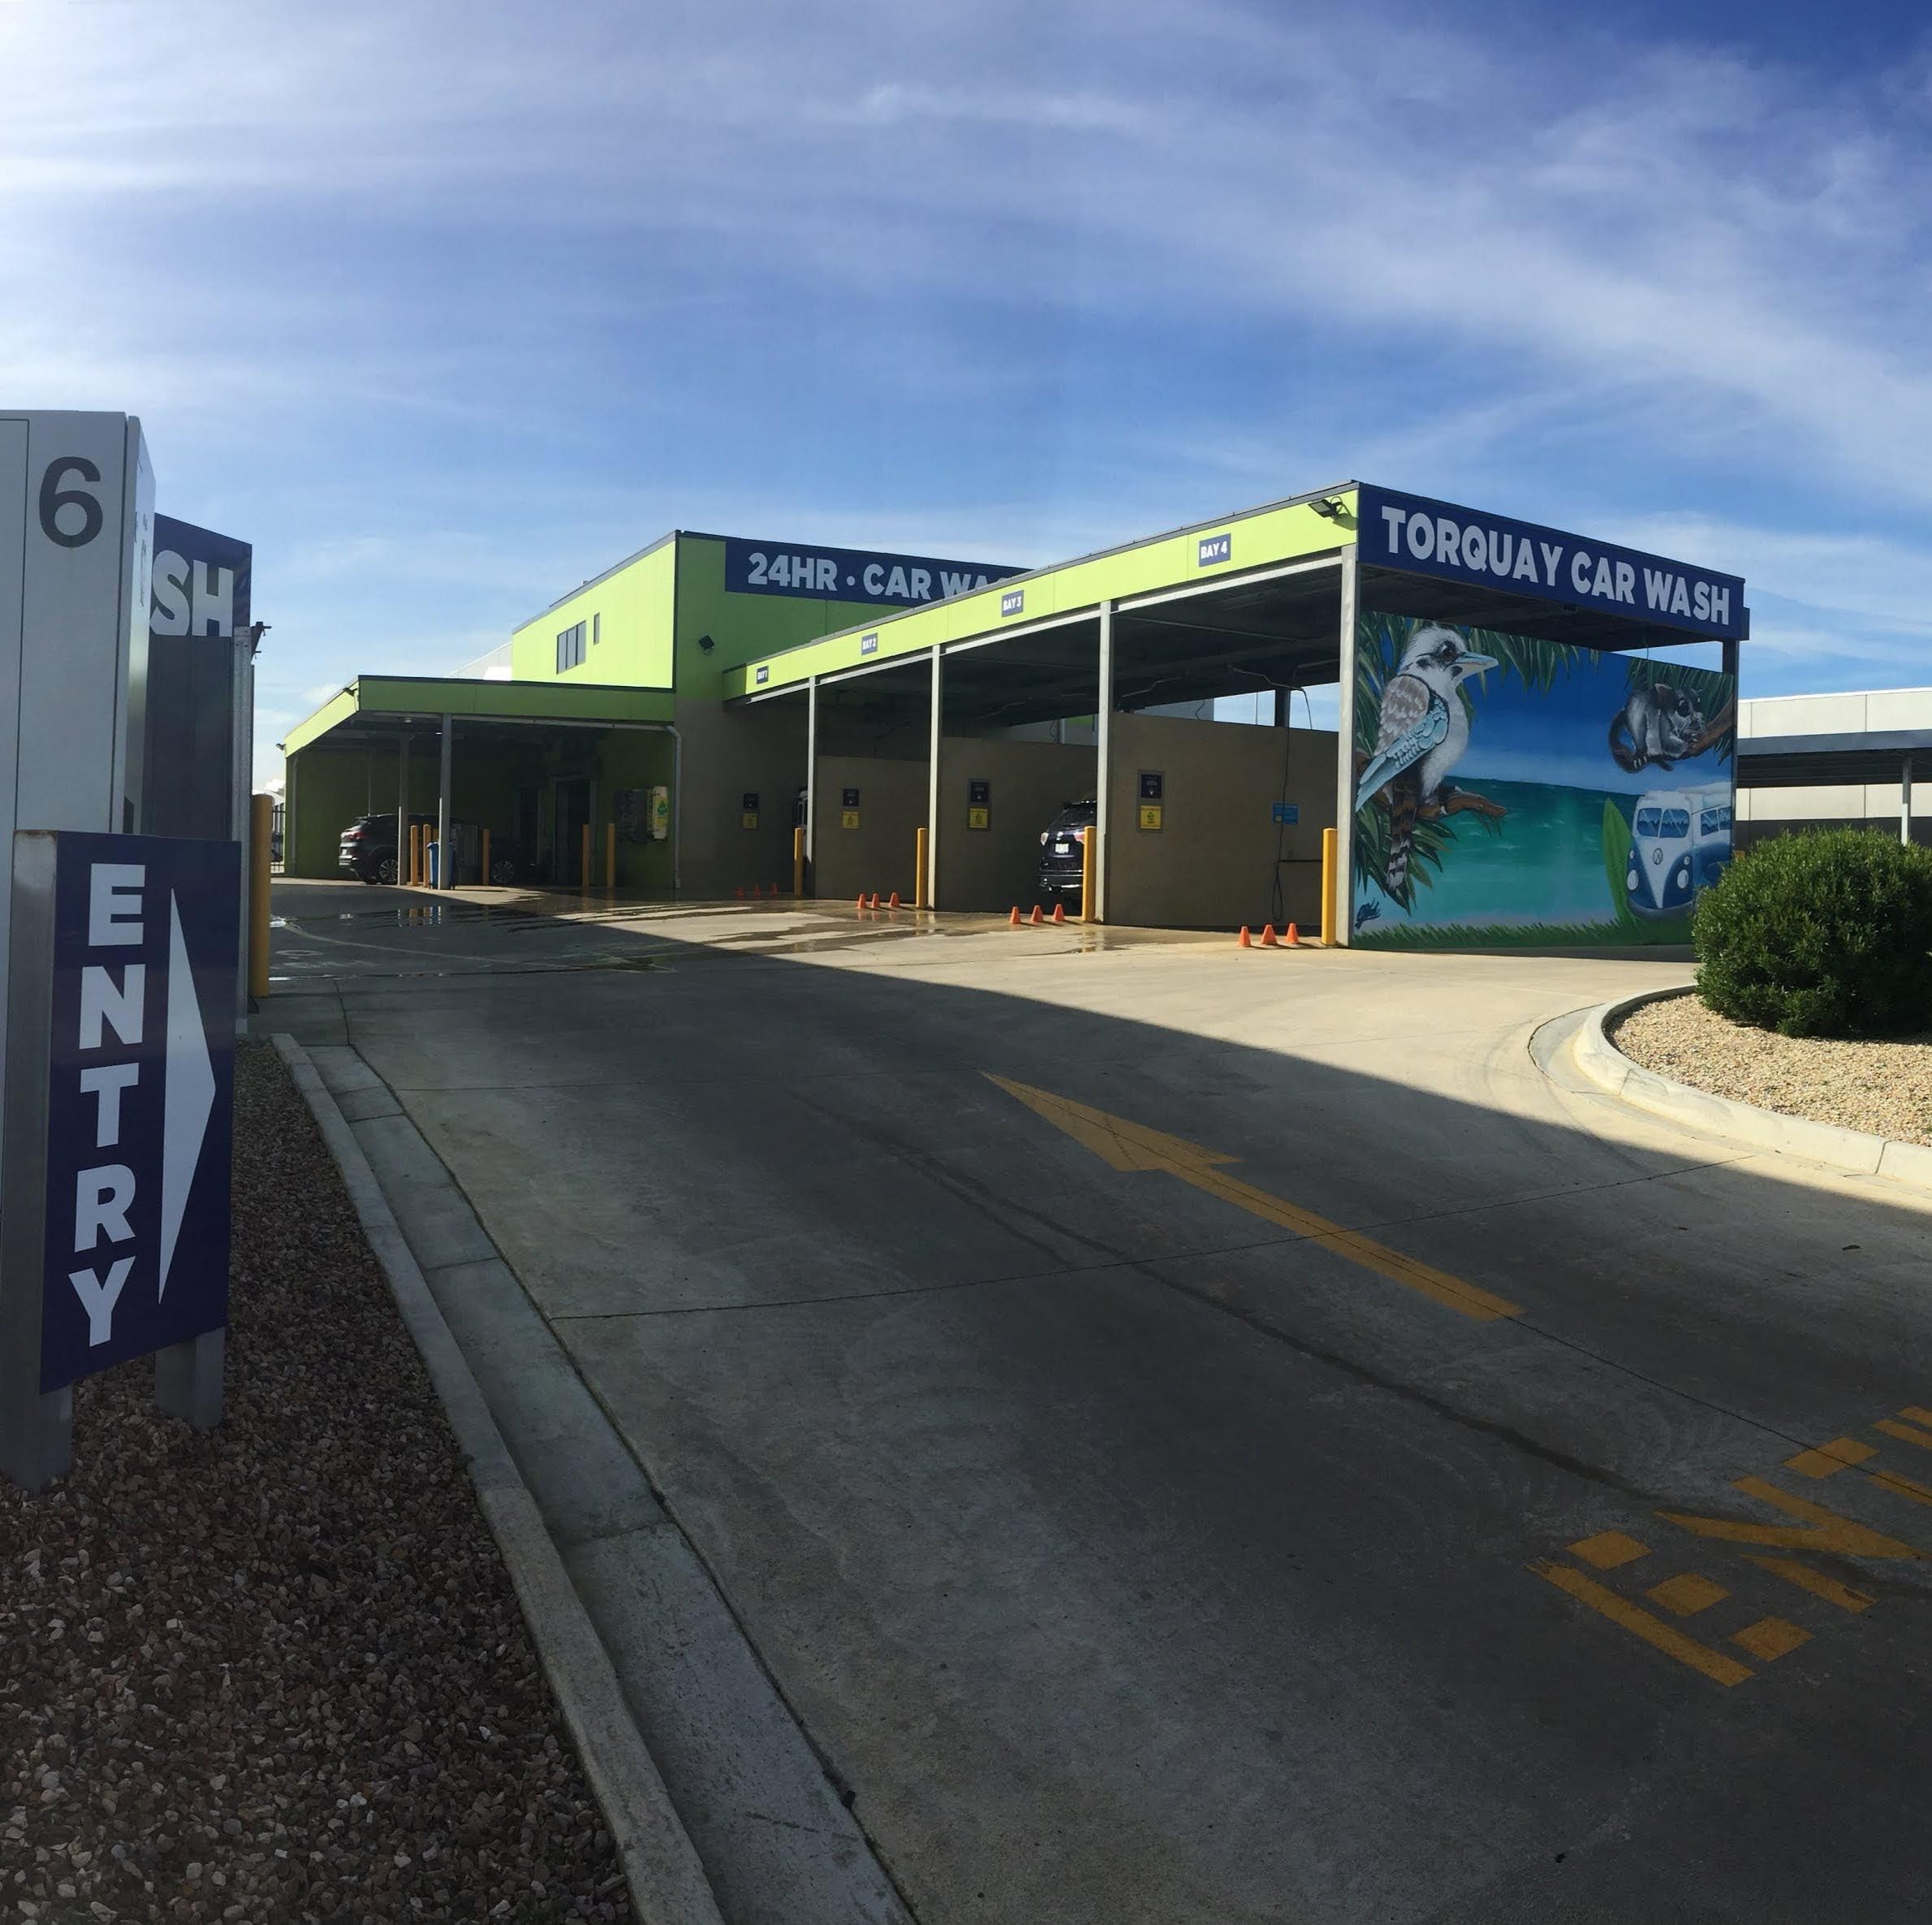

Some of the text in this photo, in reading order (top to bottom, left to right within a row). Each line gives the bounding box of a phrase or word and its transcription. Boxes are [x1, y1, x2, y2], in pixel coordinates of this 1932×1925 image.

[39, 456, 103, 548] 6
[748, 552, 838, 591] 24HR
[863, 563, 931, 600] CAR
[1201, 541, 1227, 559] BAY 4
[1382, 506, 1730, 625] TORQUAY CAR WASH
[149, 550, 234, 637] SH
[1003, 596, 1022, 611] BAY 3
[863, 637, 877, 650] BAY 2
[69, 862, 146, 1347] ENTRY
